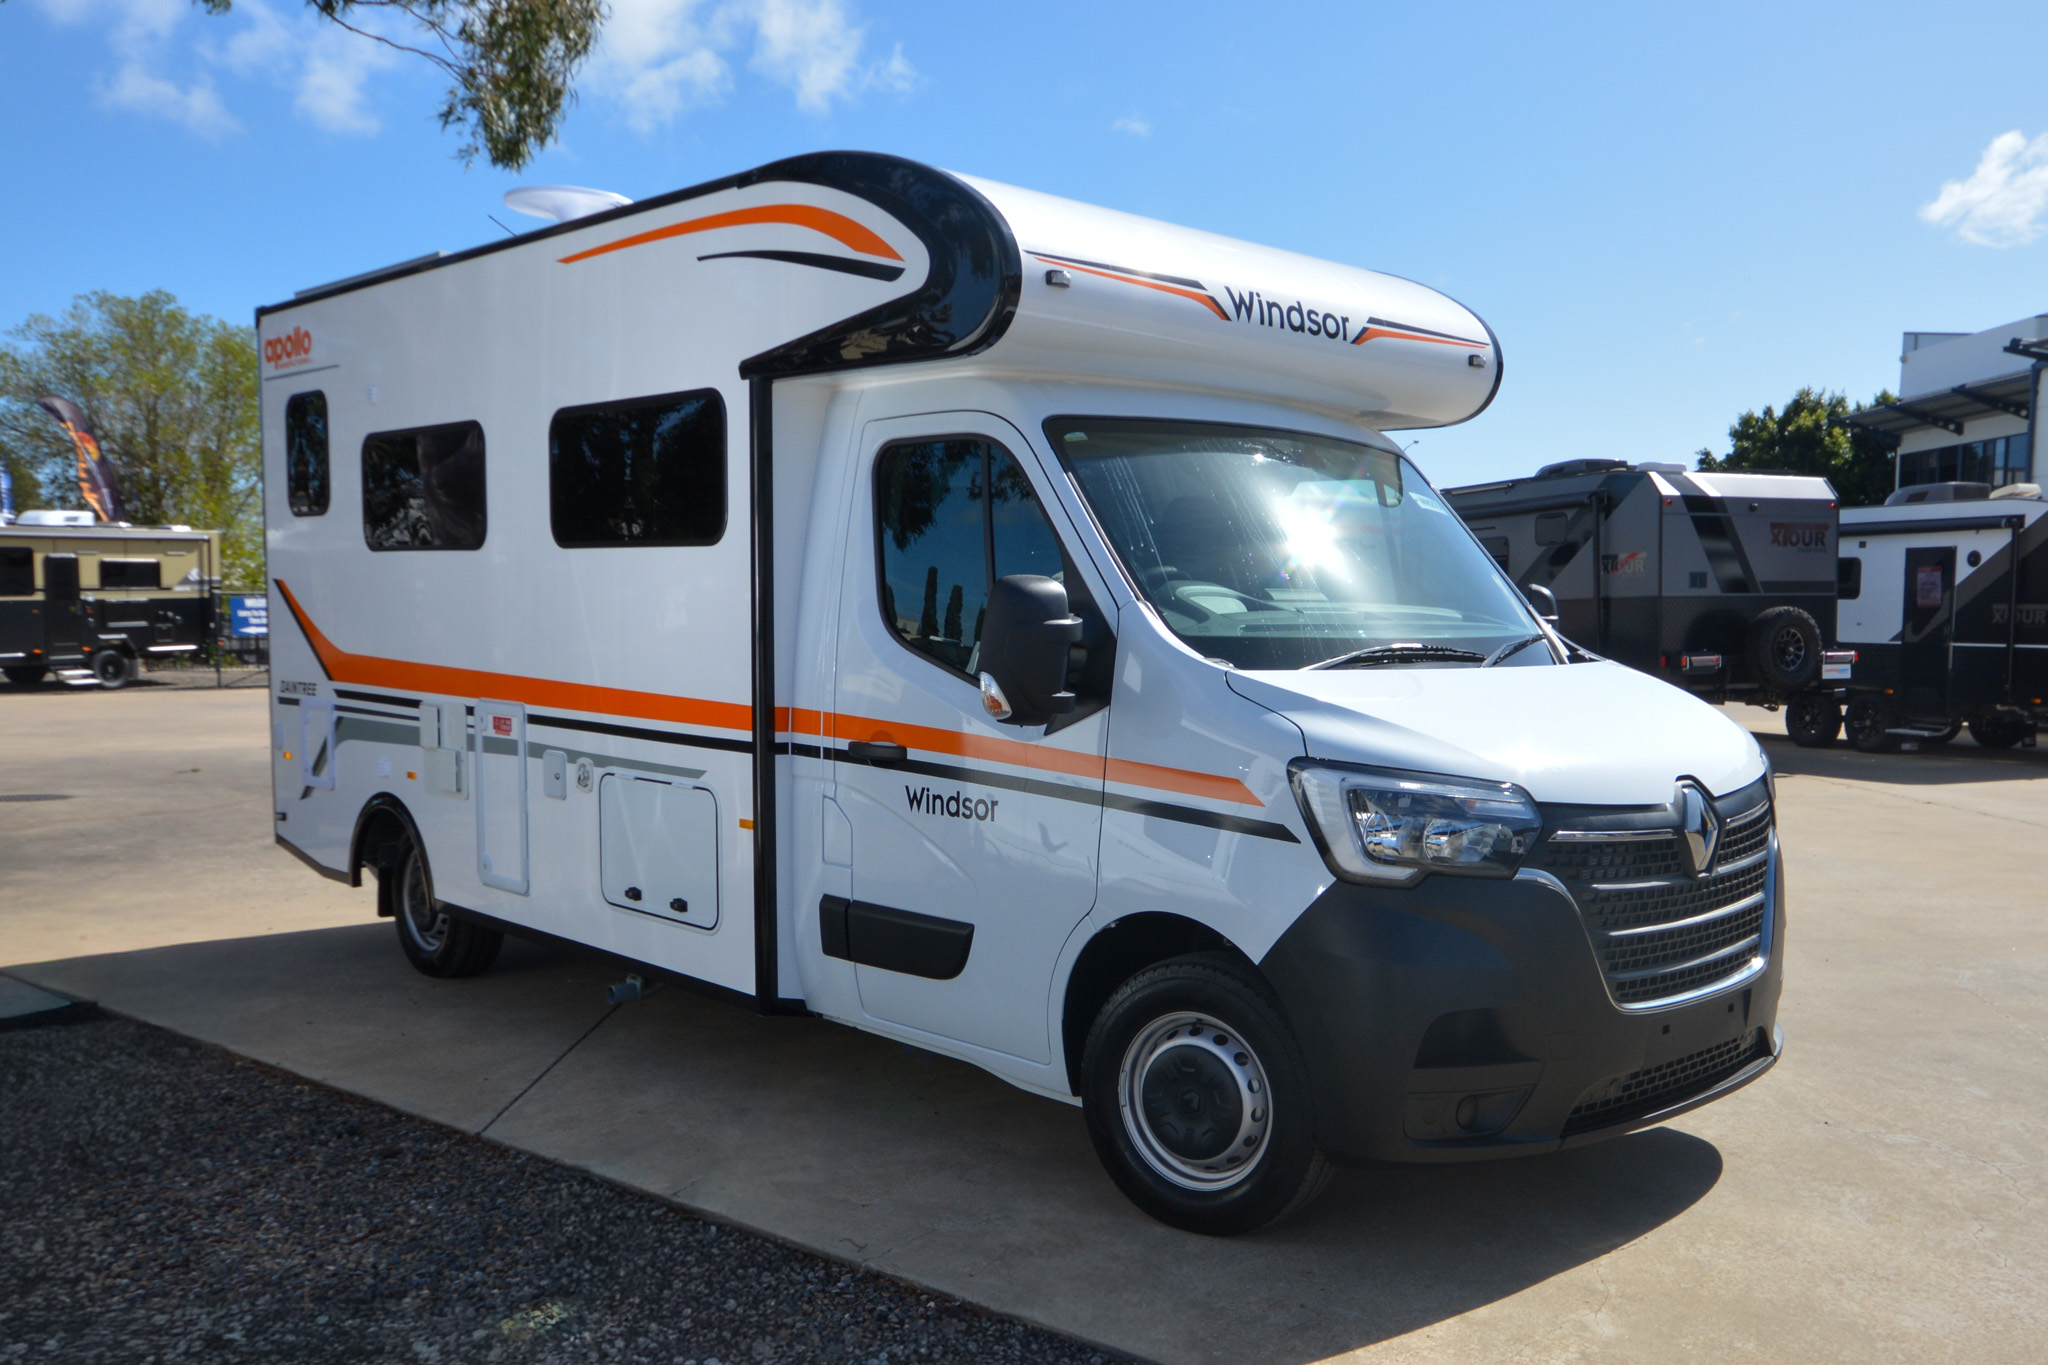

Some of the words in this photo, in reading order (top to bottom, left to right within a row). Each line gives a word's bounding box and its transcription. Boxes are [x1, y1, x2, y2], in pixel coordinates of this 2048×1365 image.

[1224, 285, 1349, 341] Windsor
[264, 326, 312, 371] apollo
[280, 680, 317, 696] DAINTREE
[905, 785, 999, 822] Windsor
